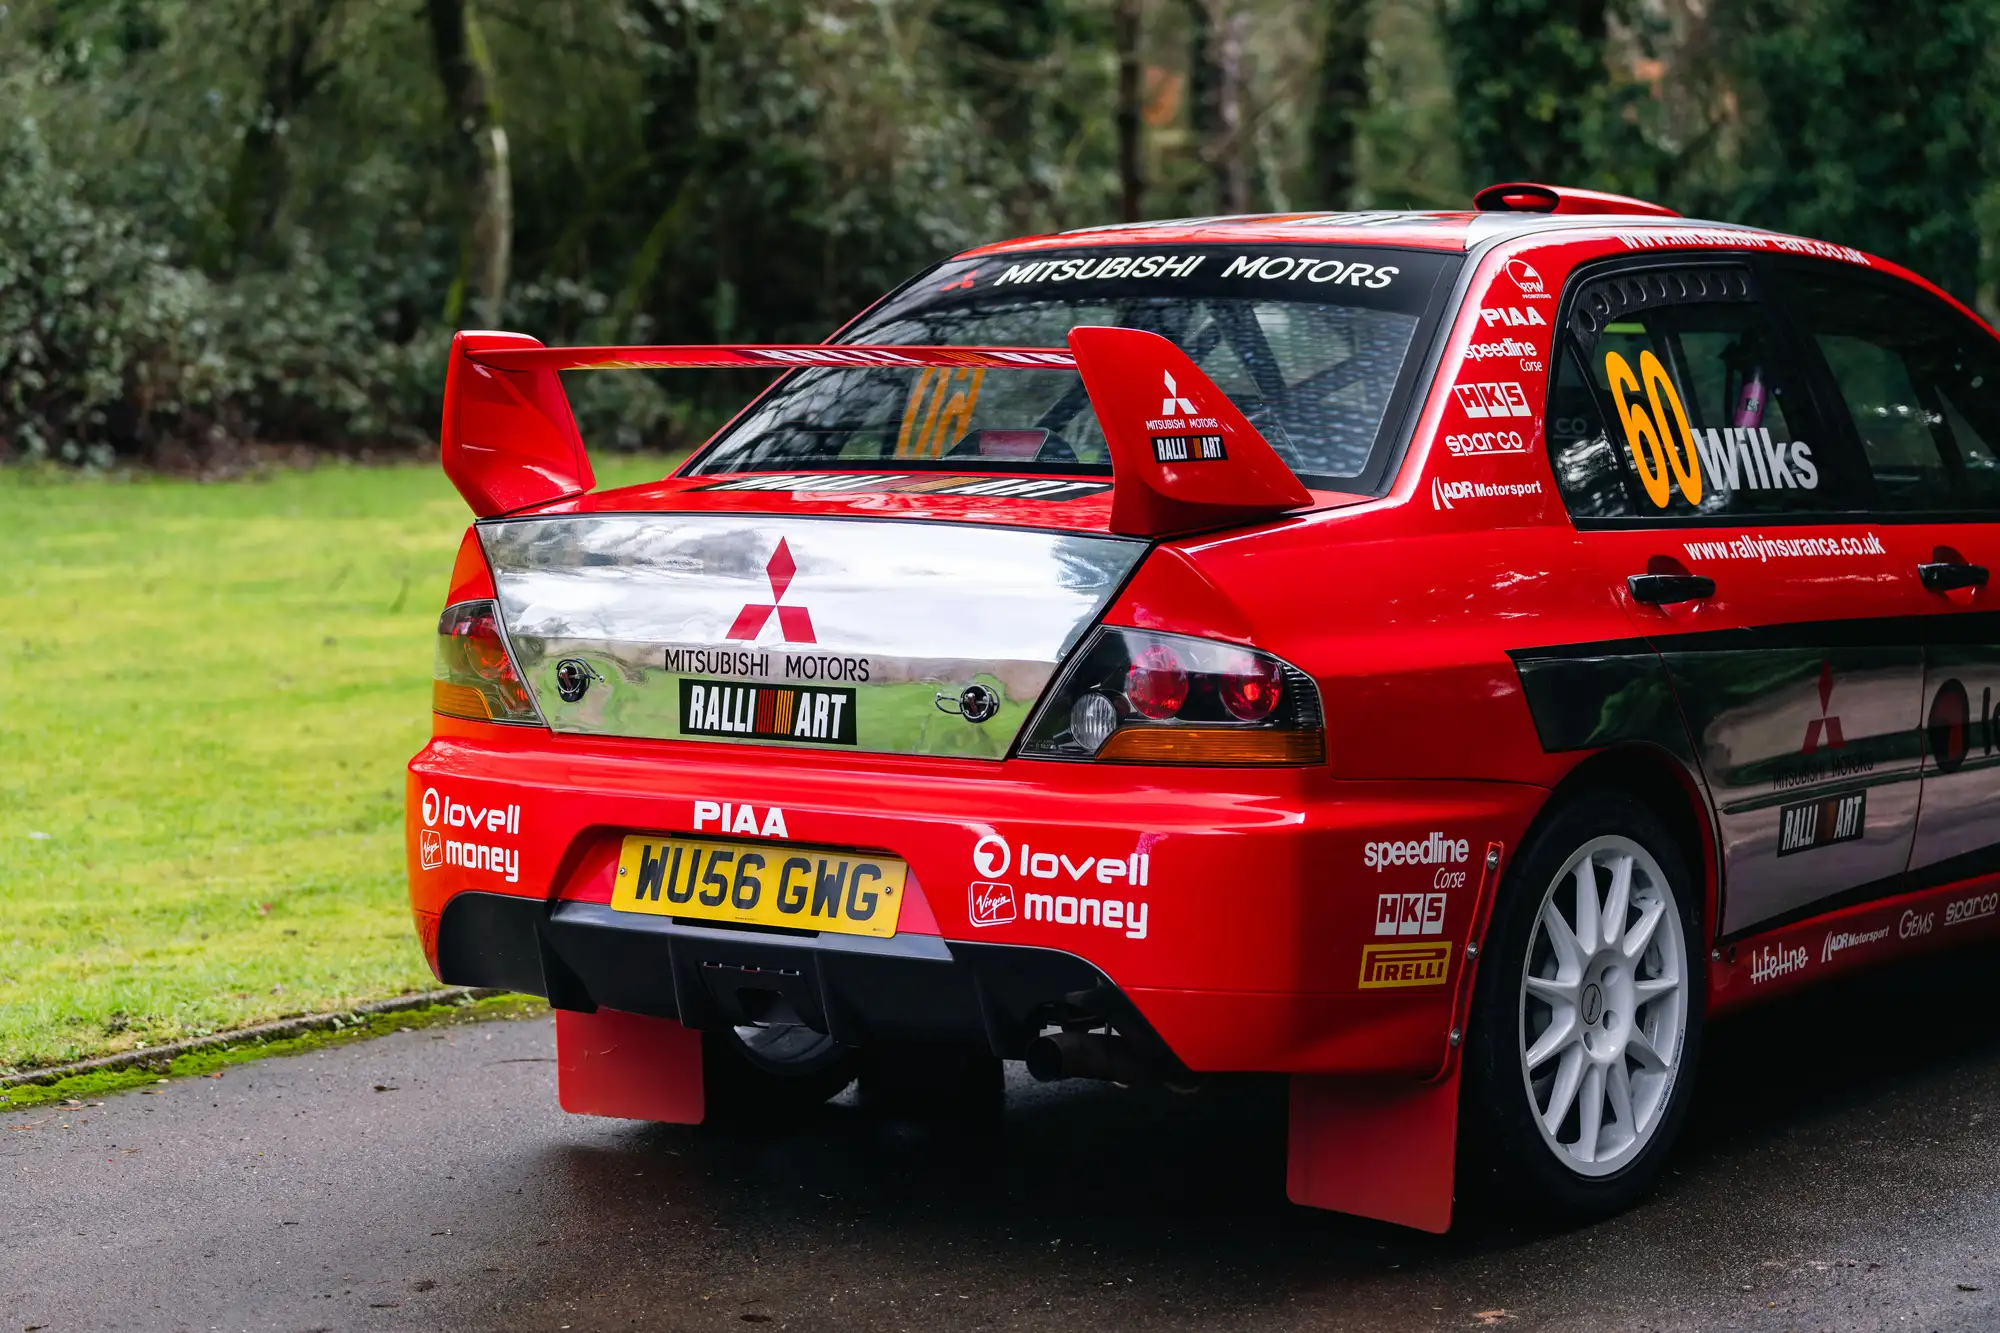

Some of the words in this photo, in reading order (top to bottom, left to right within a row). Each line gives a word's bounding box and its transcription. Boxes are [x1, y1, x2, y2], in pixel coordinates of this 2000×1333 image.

[993, 255, 1206, 286] MITSUBISHI
[1221, 255, 1400, 289] MOTORS
[1479, 306, 1547, 327] PIAA
[1464, 337, 1537, 362] speedline
[1520, 358, 1543, 372] Corse
[1454, 384, 1529, 412] HKS
[1146, 418, 1186, 430] MITSUBISHI
[1189, 418, 1218, 429] MOTORS
[1605, 350, 1702, 508] 60
[1445, 431, 1524, 456] sparco
[1690, 427, 1818, 490] Wilks
[1444, 481, 1475, 499] ADR
[1475, 481, 1542, 497] Motorsport
[1683, 532, 1886, 562] www.rallyinsurance.co.uk
[664, 649, 769, 676] MITSUBISHI
[785, 655, 870, 682] MOTORS
[443, 796, 520, 834] lovell
[693, 800, 788, 838] PIAA
[446, 840, 519, 883] money
[1020, 844, 1149, 886] lovell
[1364, 832, 1470, 873] speedline
[635, 845, 766, 910] WU56
[776, 857, 882, 921] GWG
[1433, 867, 1466, 889] Corse
[976, 885, 1011, 919] Virgin
[1024, 893, 1148, 939] money
[1377, 895, 1445, 928] HKS
[1945, 892, 1999, 924] sparco
[1848, 926, 1890, 946] Motorsport
[1363, 947, 1447, 982] PIRELLI
